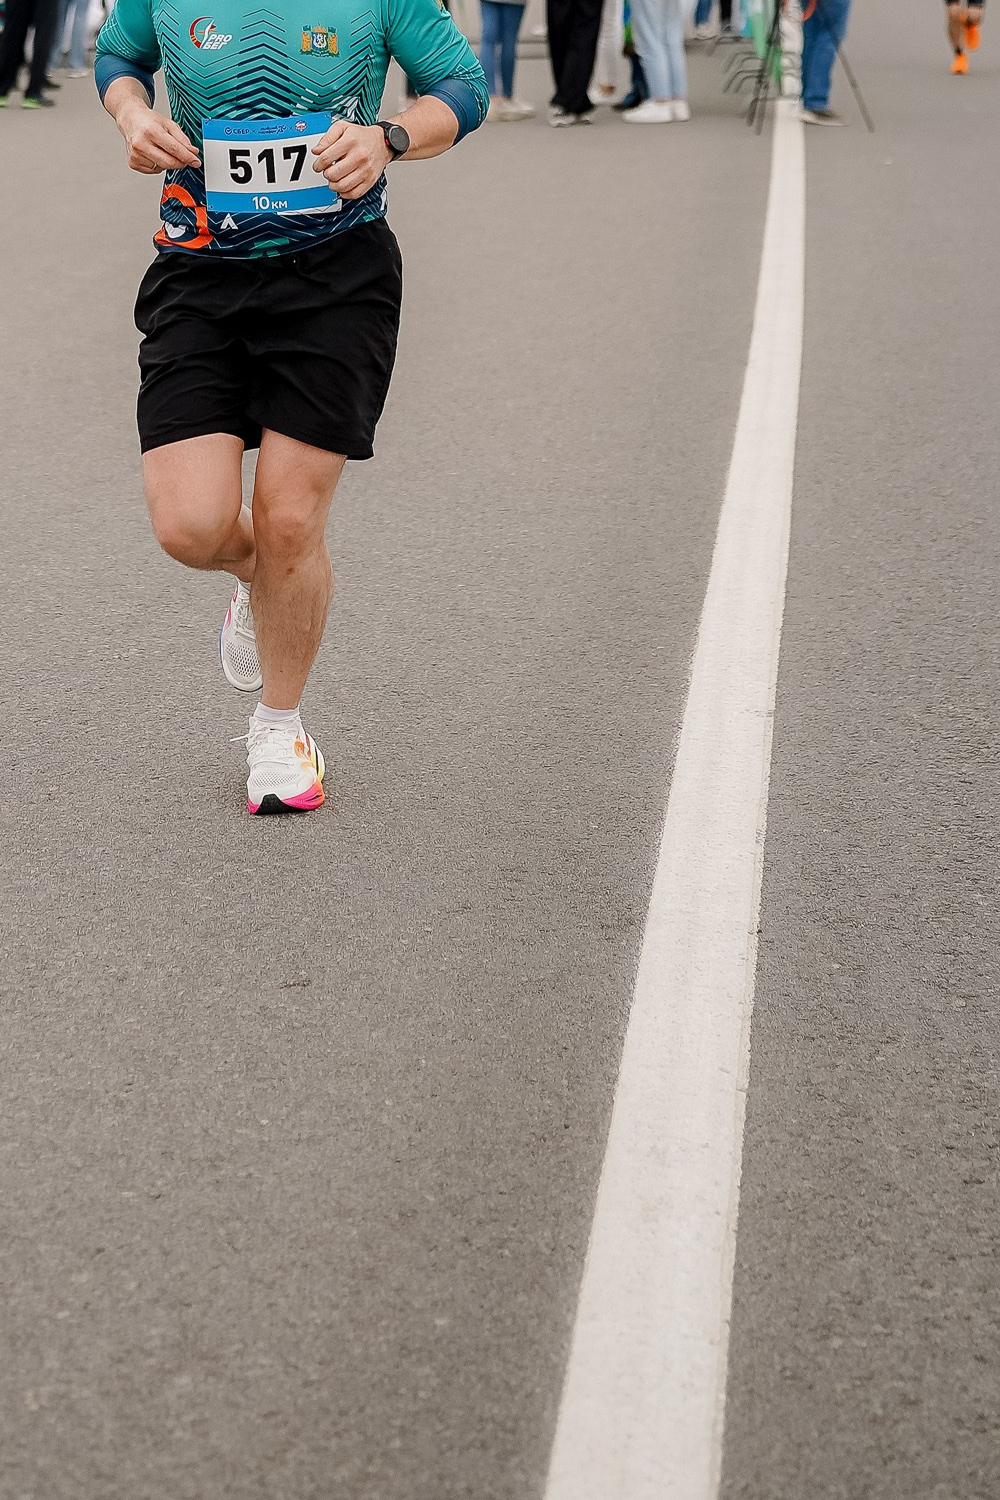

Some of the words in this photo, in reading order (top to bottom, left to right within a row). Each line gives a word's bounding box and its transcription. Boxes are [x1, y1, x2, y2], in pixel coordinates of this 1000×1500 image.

[208, 34, 233, 42] PRO
[203, 42, 227, 50] БЕГ
[229, 144, 307, 184] 517
[252, 196, 270, 210] 10
